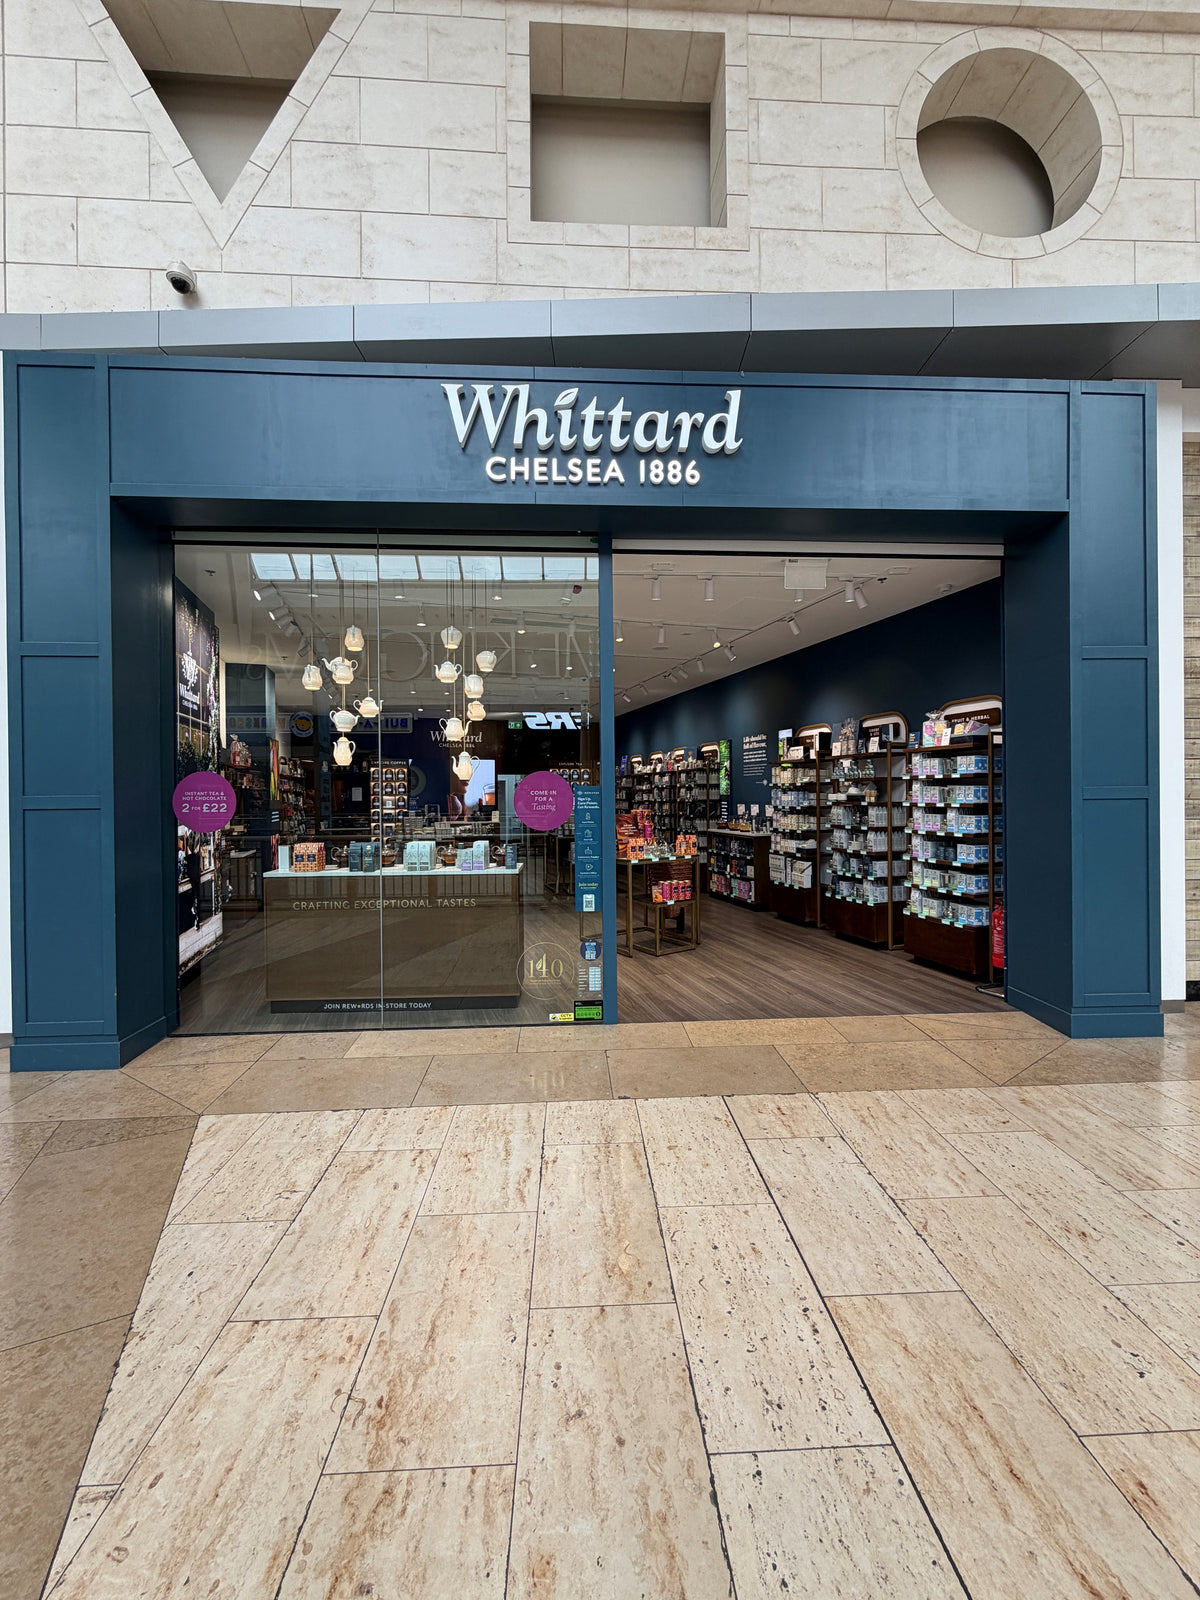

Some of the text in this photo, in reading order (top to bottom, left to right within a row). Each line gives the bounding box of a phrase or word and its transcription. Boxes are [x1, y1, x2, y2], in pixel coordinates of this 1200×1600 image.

[440, 383, 743, 455] Whittard
[485, 456, 701, 486] CHELSEA 1886
[430, 730, 483, 743] Whard
[181, 803, 190, 813] 2
[202, 803, 228, 813] £22
[531, 802, 556, 811] Tasting
[292, 898, 477, 911] CRAFTING EXCEPTIONAL TASTES
[528, 953, 564, 978] 140
